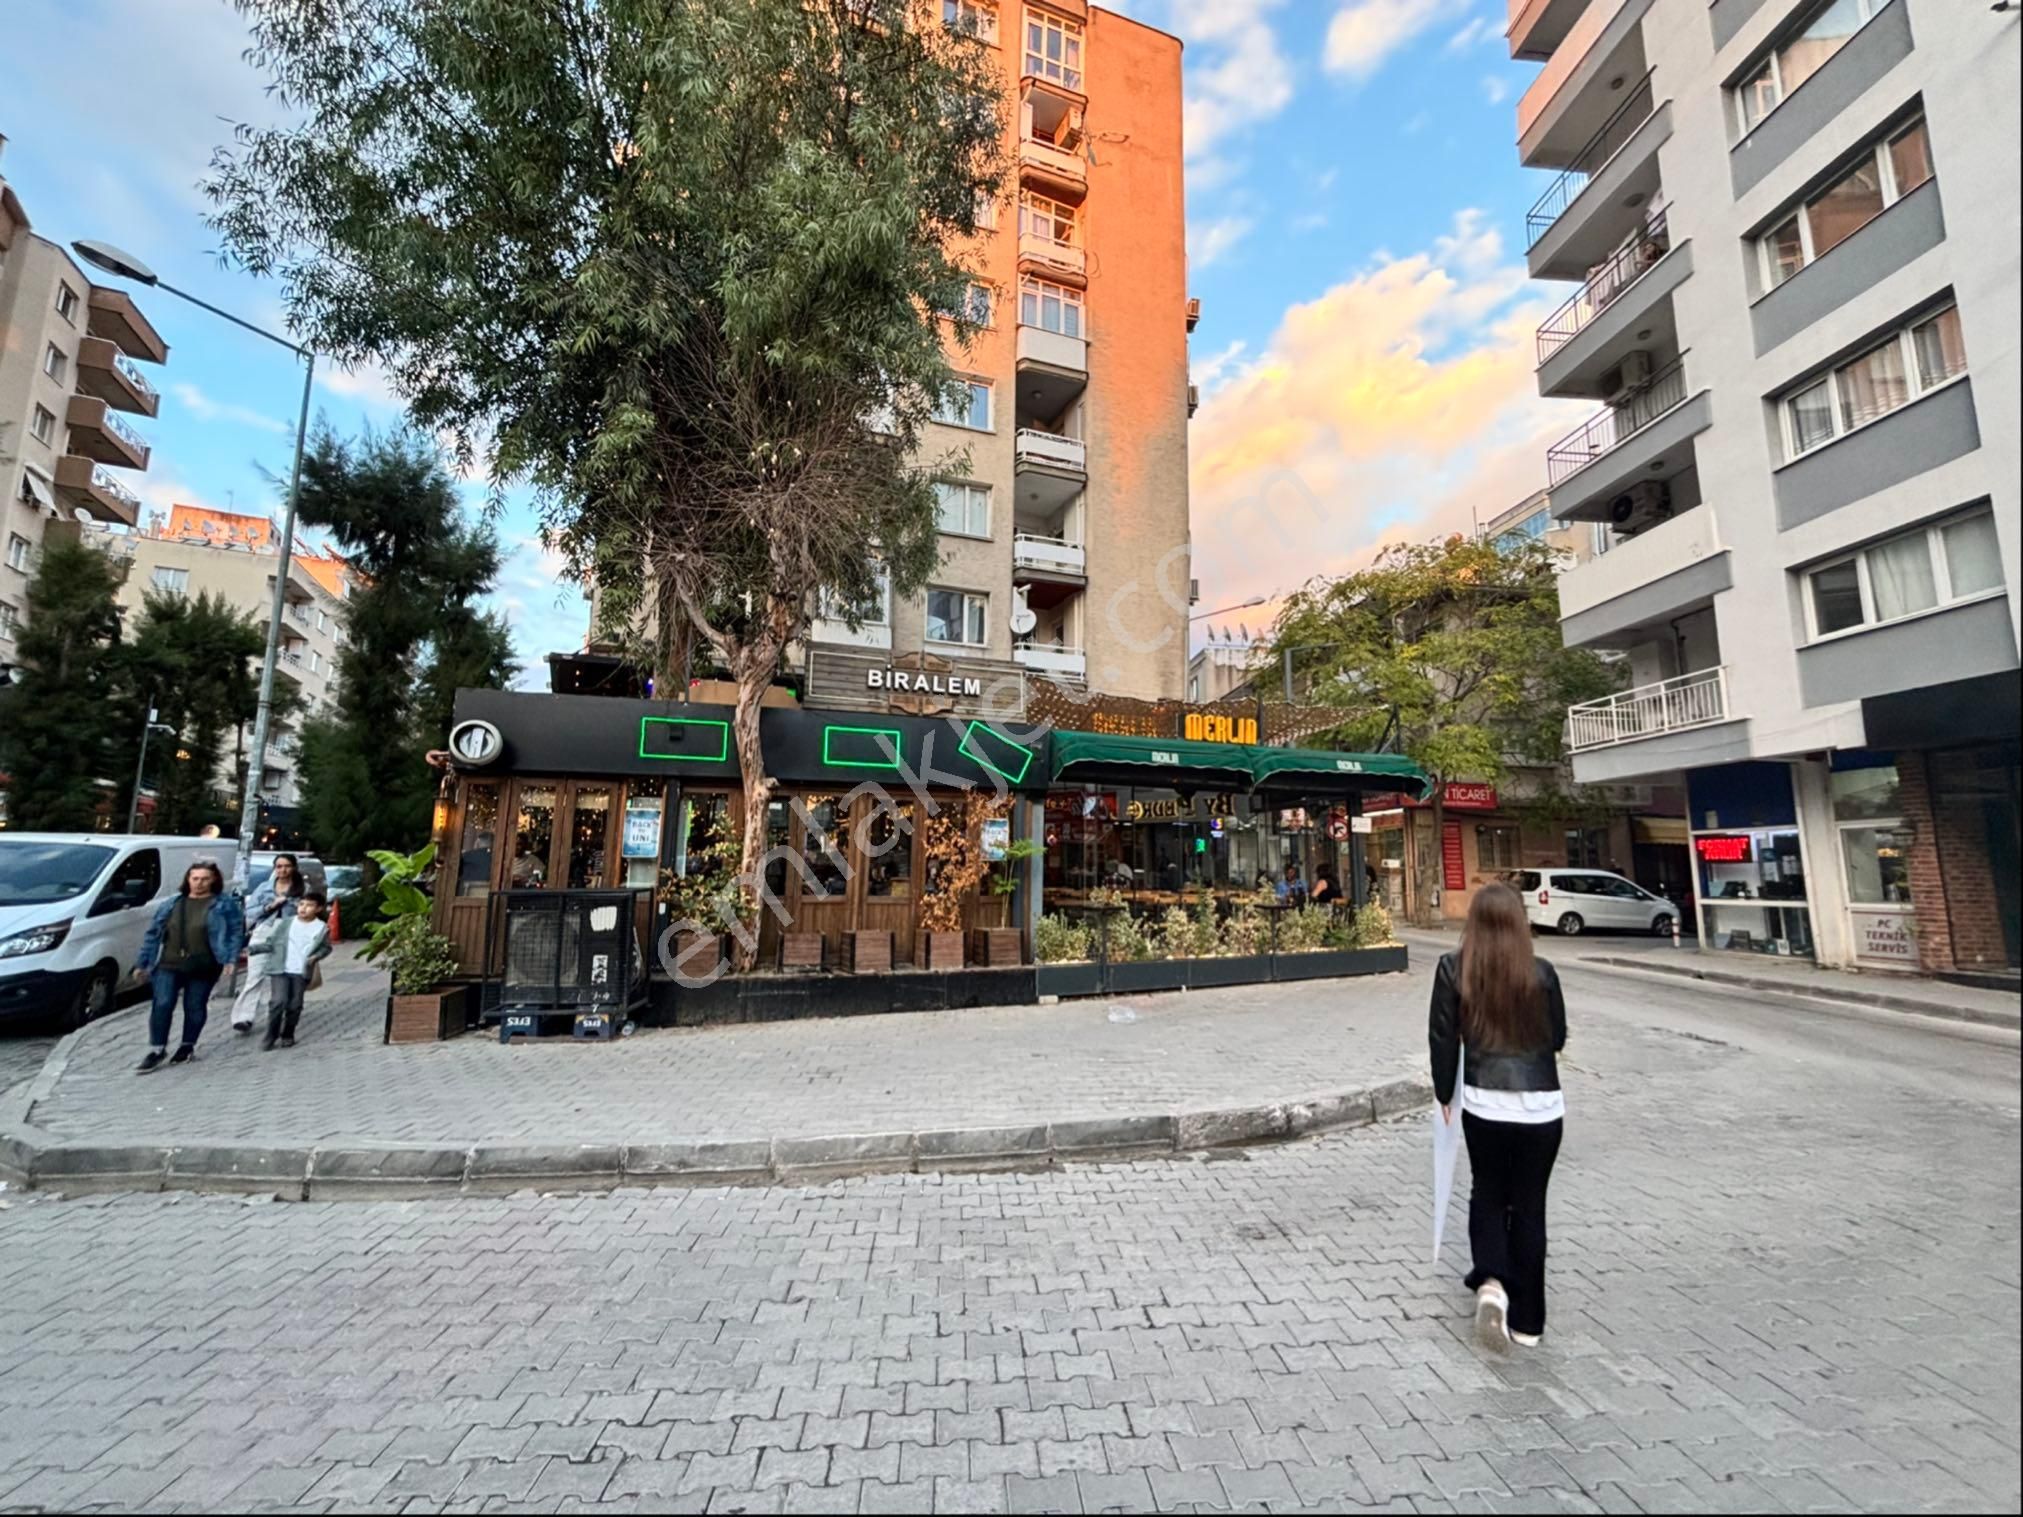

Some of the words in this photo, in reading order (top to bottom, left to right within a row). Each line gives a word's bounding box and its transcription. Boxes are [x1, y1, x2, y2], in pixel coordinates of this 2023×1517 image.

[867, 664, 980, 695] BİRALEM
[1184, 713, 1257, 745] MERLIN
[1450, 786, 1491, 801] TİCARET
[1877, 919, 1892, 929] PC
